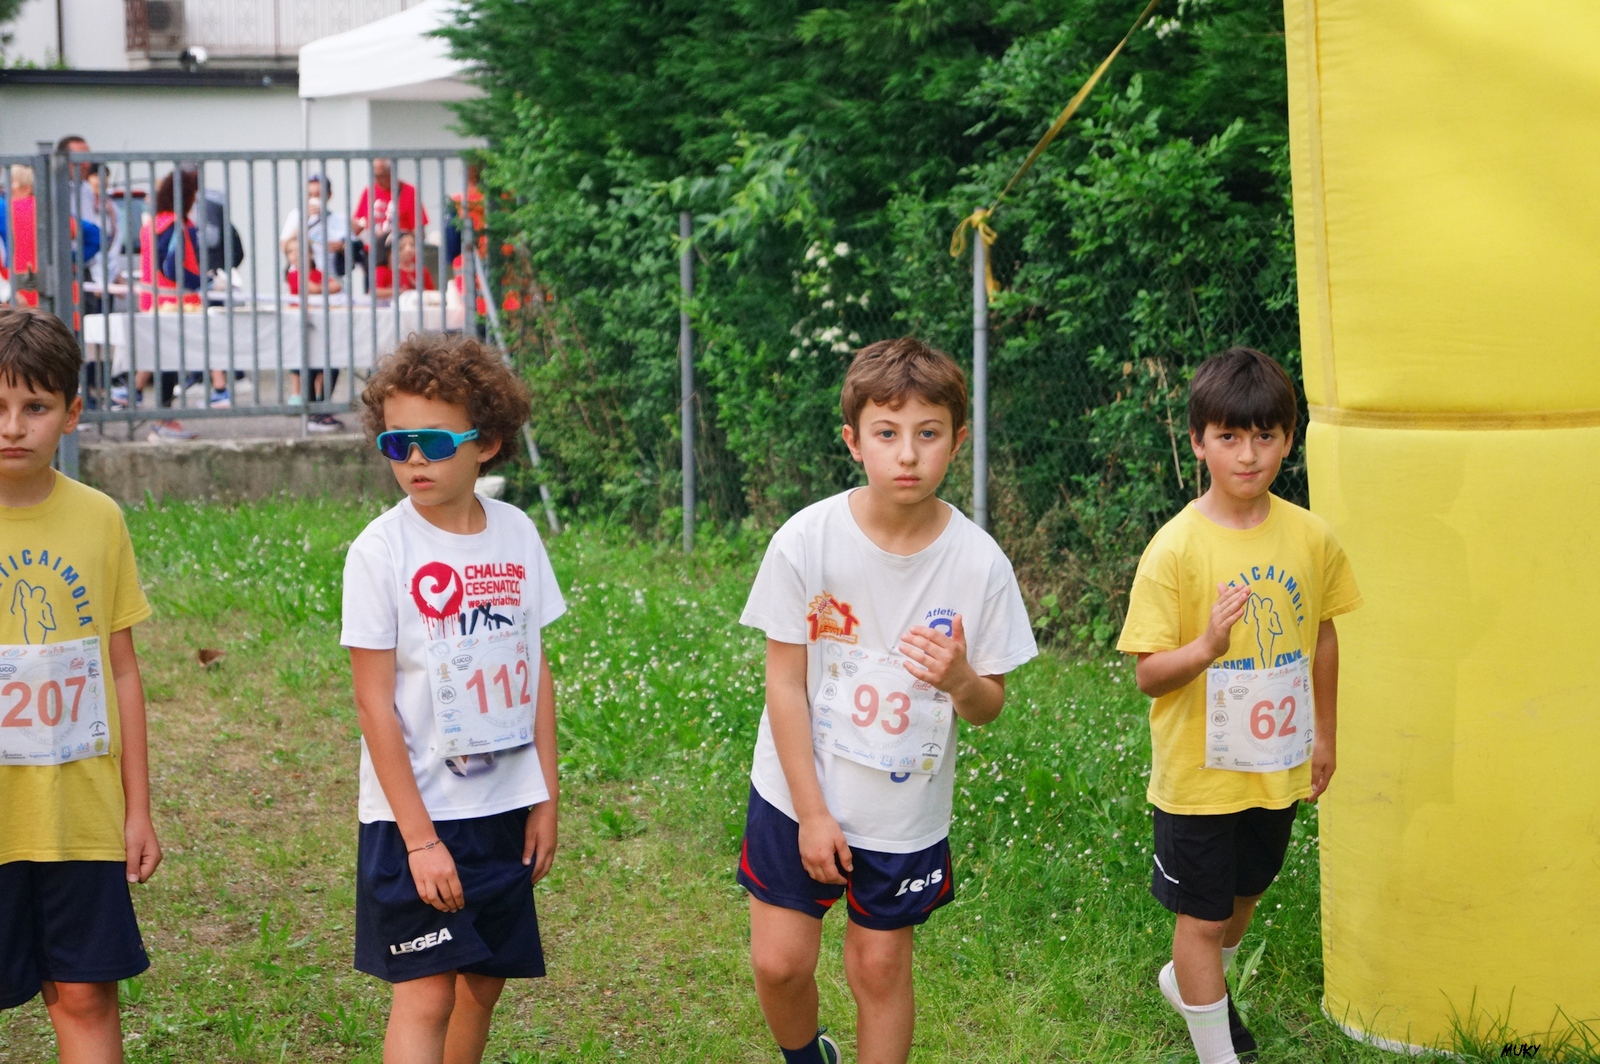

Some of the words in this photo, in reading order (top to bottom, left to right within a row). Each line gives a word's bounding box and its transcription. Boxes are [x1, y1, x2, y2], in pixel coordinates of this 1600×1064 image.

[0, 549, 93, 627] TICAIMOLA
[1, 675, 86, 728] 207
[466, 660, 530, 714] 112
[852, 684, 911, 735] 93
[1250, 696, 1296, 740] 62
[390, 928, 453, 955] LEGEA
